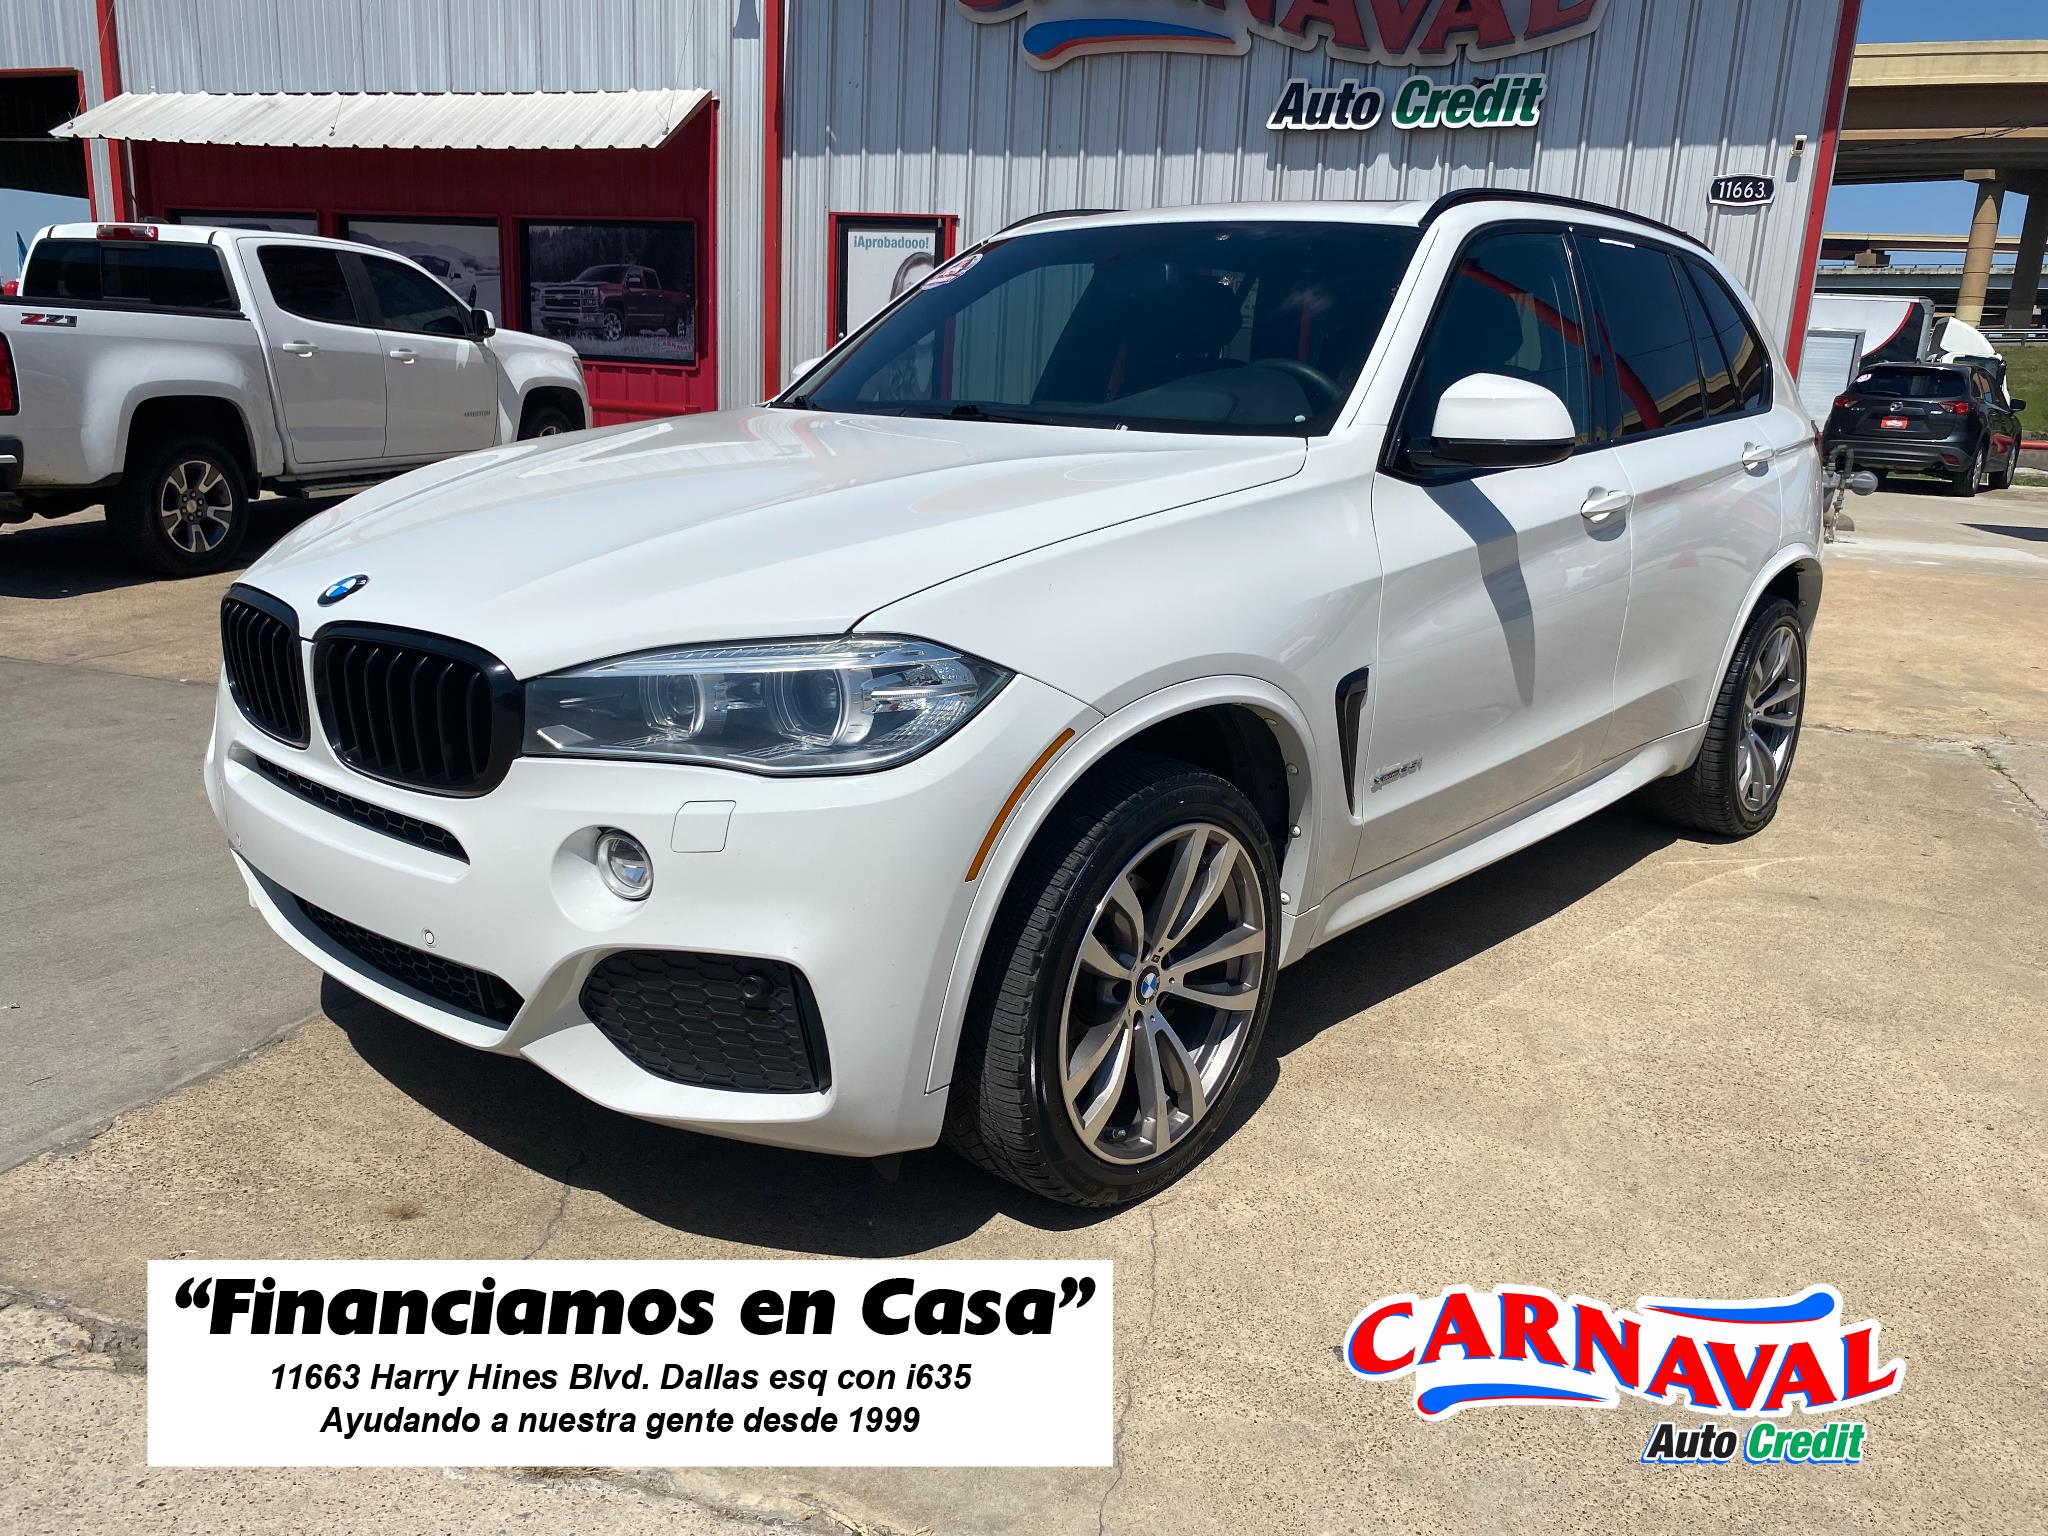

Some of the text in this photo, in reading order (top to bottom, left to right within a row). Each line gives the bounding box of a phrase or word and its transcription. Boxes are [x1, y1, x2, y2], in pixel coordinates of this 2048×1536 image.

[1271, 77, 1543, 125] Auto Credit
[1719, 181, 1765, 199] 11663
[853, 235, 929, 250] ¡Aprobadooo!
[20, 312, 78, 327] Z71
